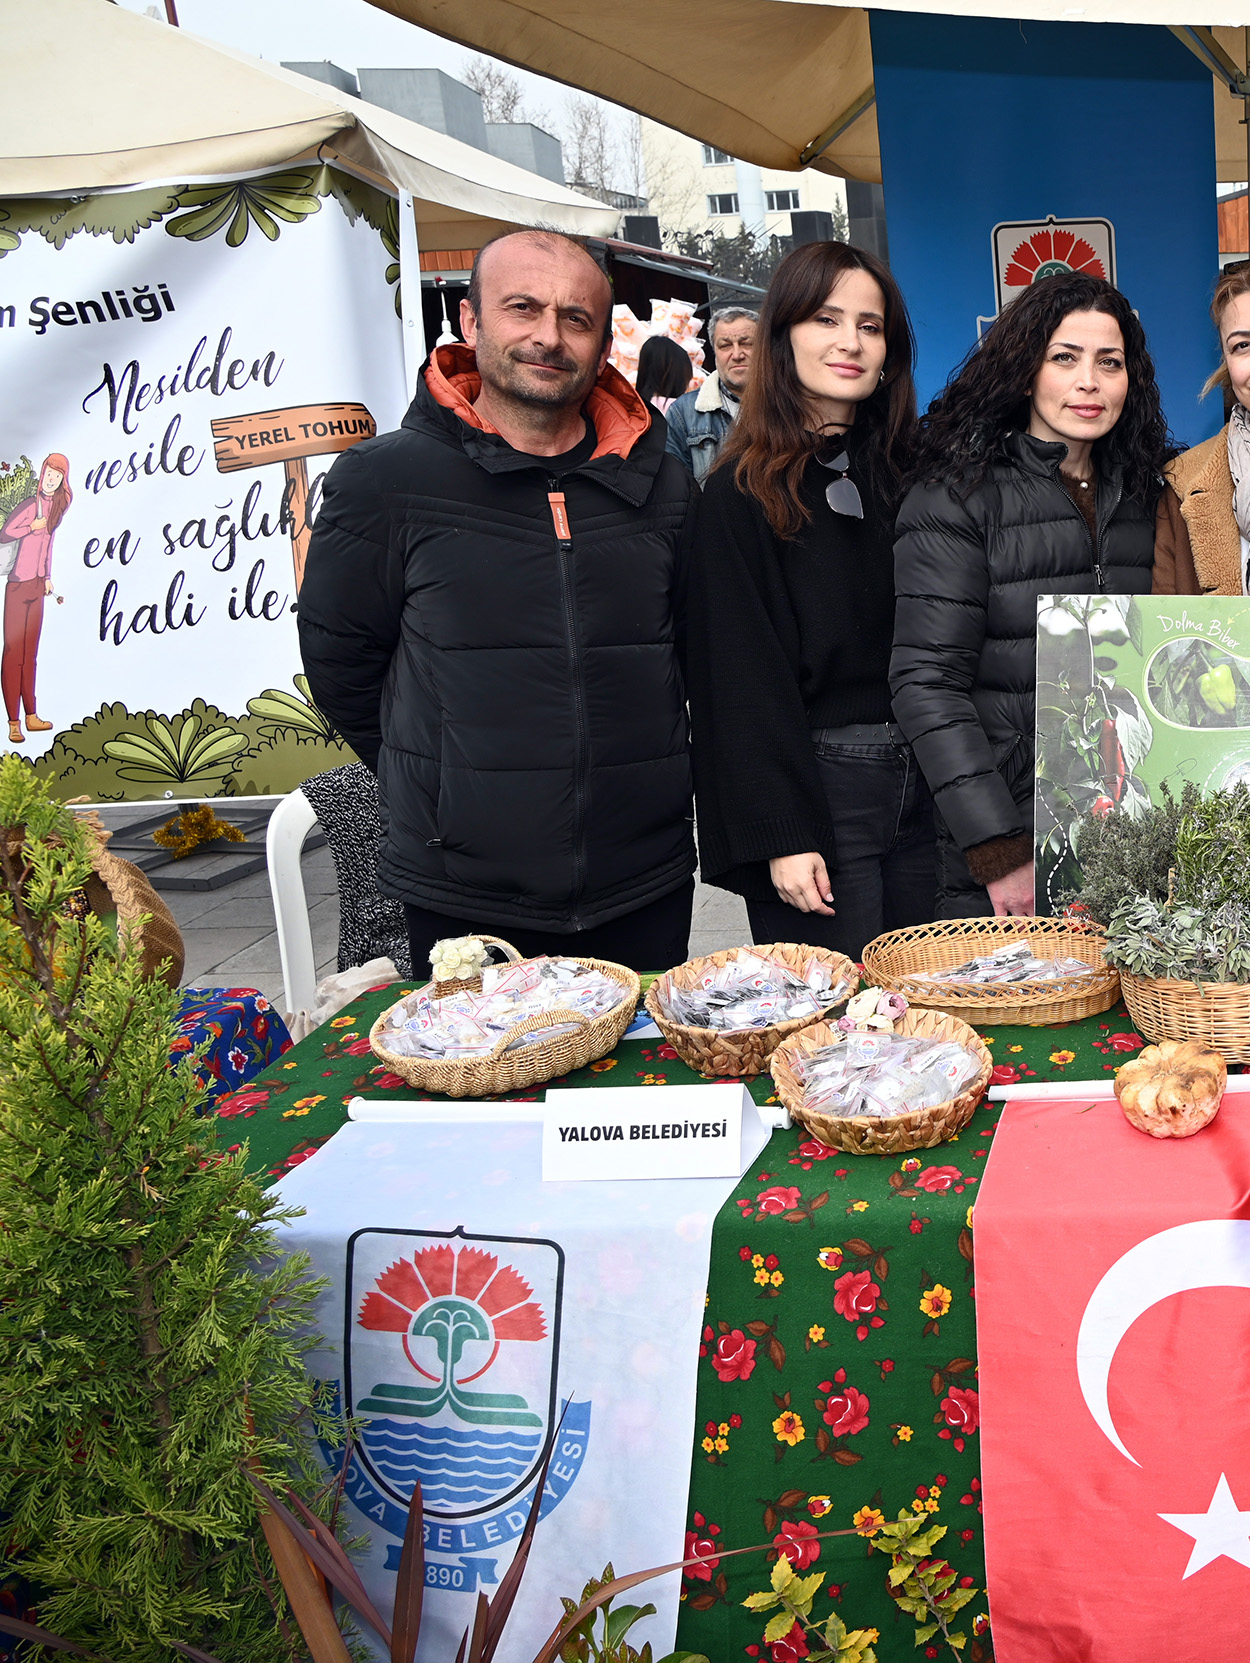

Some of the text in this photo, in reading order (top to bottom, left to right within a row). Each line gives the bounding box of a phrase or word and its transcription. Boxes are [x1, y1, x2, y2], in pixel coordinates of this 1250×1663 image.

[28, 283, 176, 335] Şenliği
[82, 326, 285, 435] Nesilden
[85, 413, 206, 495] nesile
[234, 419, 371, 451] YEREL TOHUM
[83, 472, 325, 572] en sağlıkl
[99, 570, 207, 646] hali
[1157, 611, 1241, 650] Dolma Biber
[558, 1119, 727, 1142] YALOVA BELEDİYESİ
[426, 1565, 464, 1588] 890
